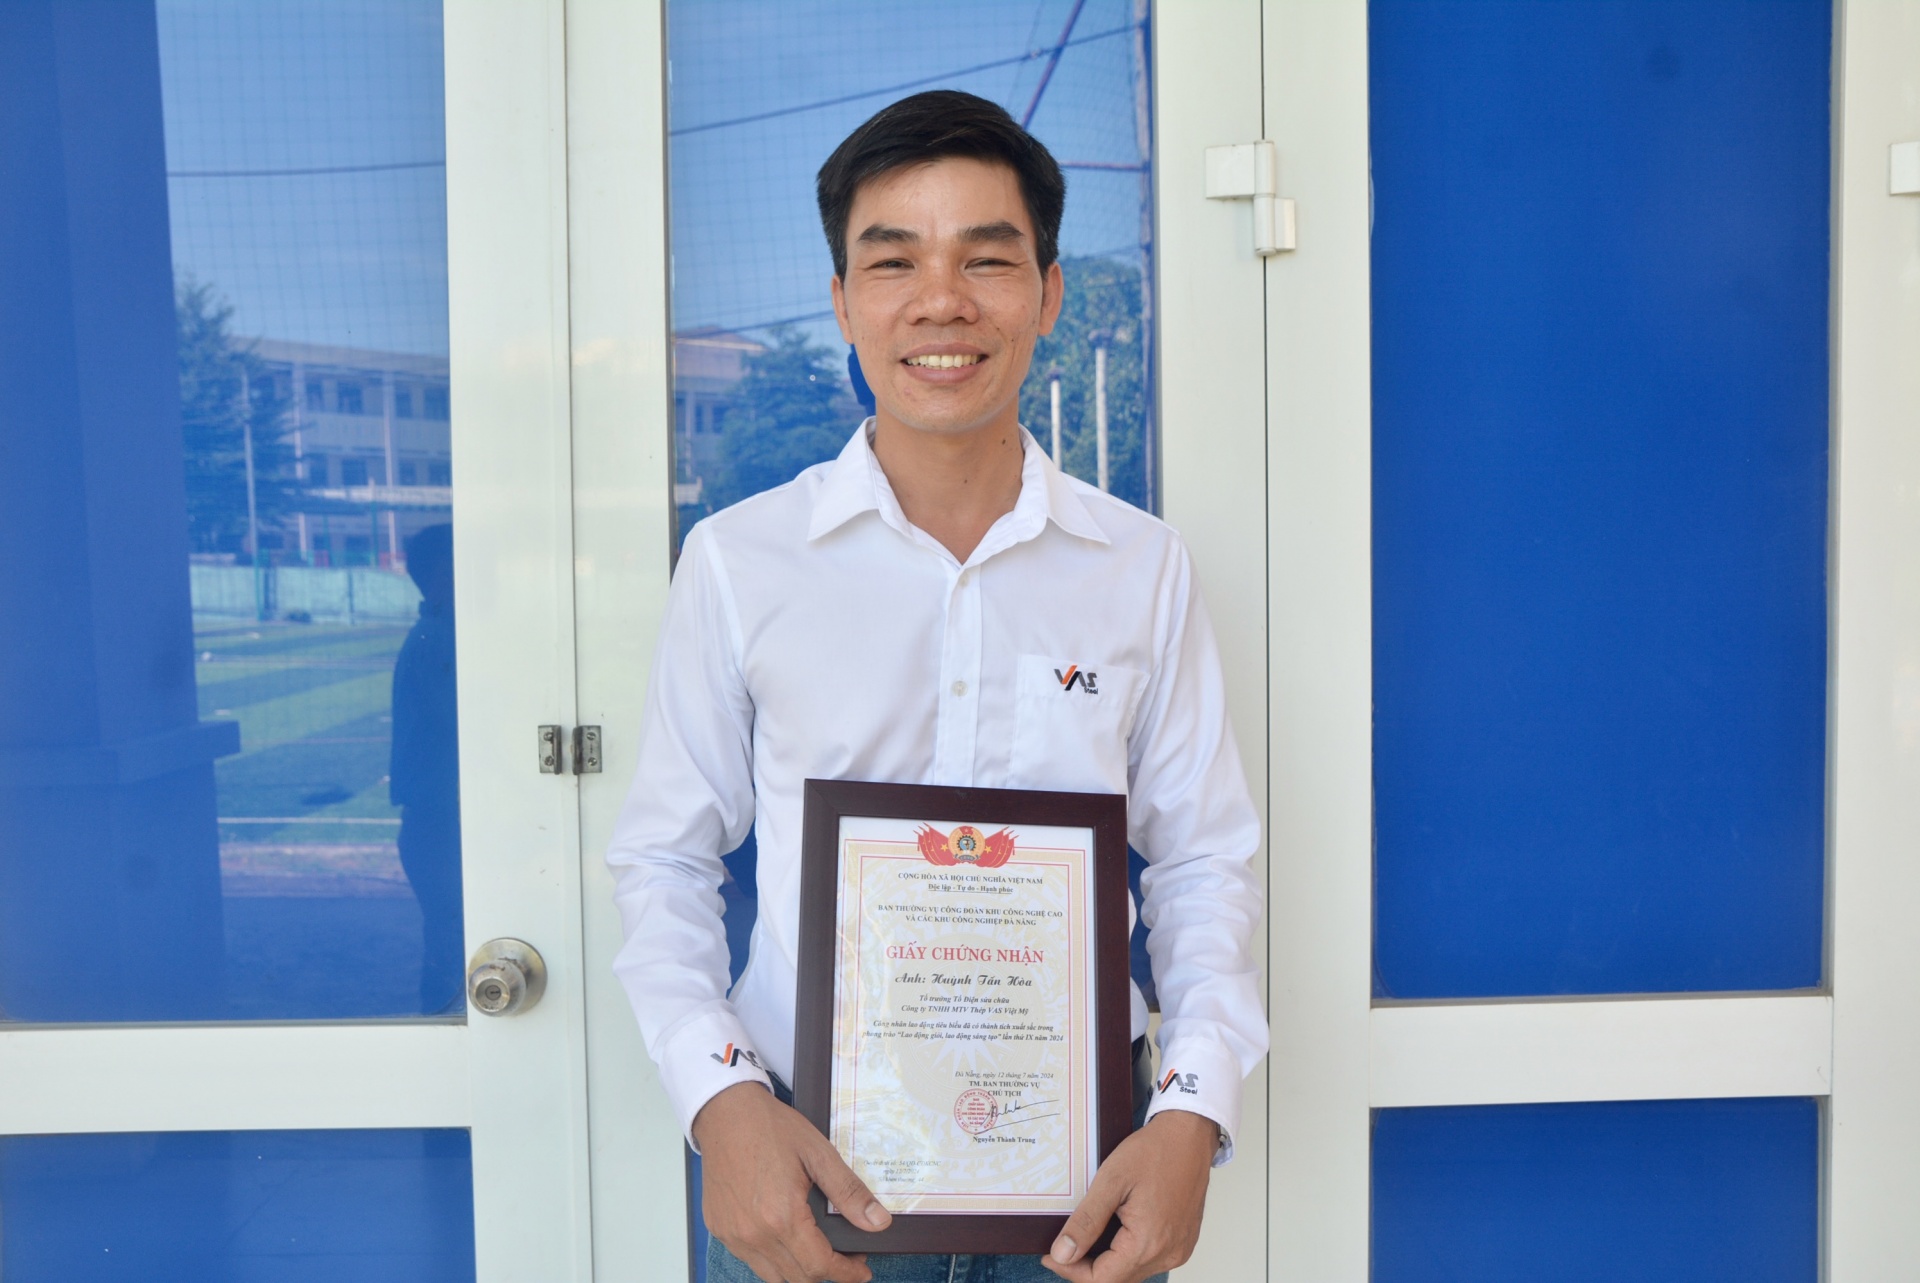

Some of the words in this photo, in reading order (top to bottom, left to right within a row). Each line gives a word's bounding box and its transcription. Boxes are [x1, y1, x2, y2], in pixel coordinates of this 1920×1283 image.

[898, 872, 919, 880] CỘNG
[951, 875, 964, 883] HỘI
[940, 906, 962, 914] CÔNG
[1002, 908, 1024, 916] CÔNG
[952, 915, 974, 923] CÔNG
[975, 917, 1003, 925] NGHIỆP
[886, 940, 927, 960] GIẤY
[931, 944, 992, 962] CHỨNG
[996, 945, 1044, 966] NHẬN
[931, 973, 972, 986] Huỳnh
[901, 1005, 918, 1013] Công
[970, 1007, 986, 1015] Thép
[999, 1080, 1029, 1088] THƯỜNG
[1179, 1086, 1198, 1095] Steel
